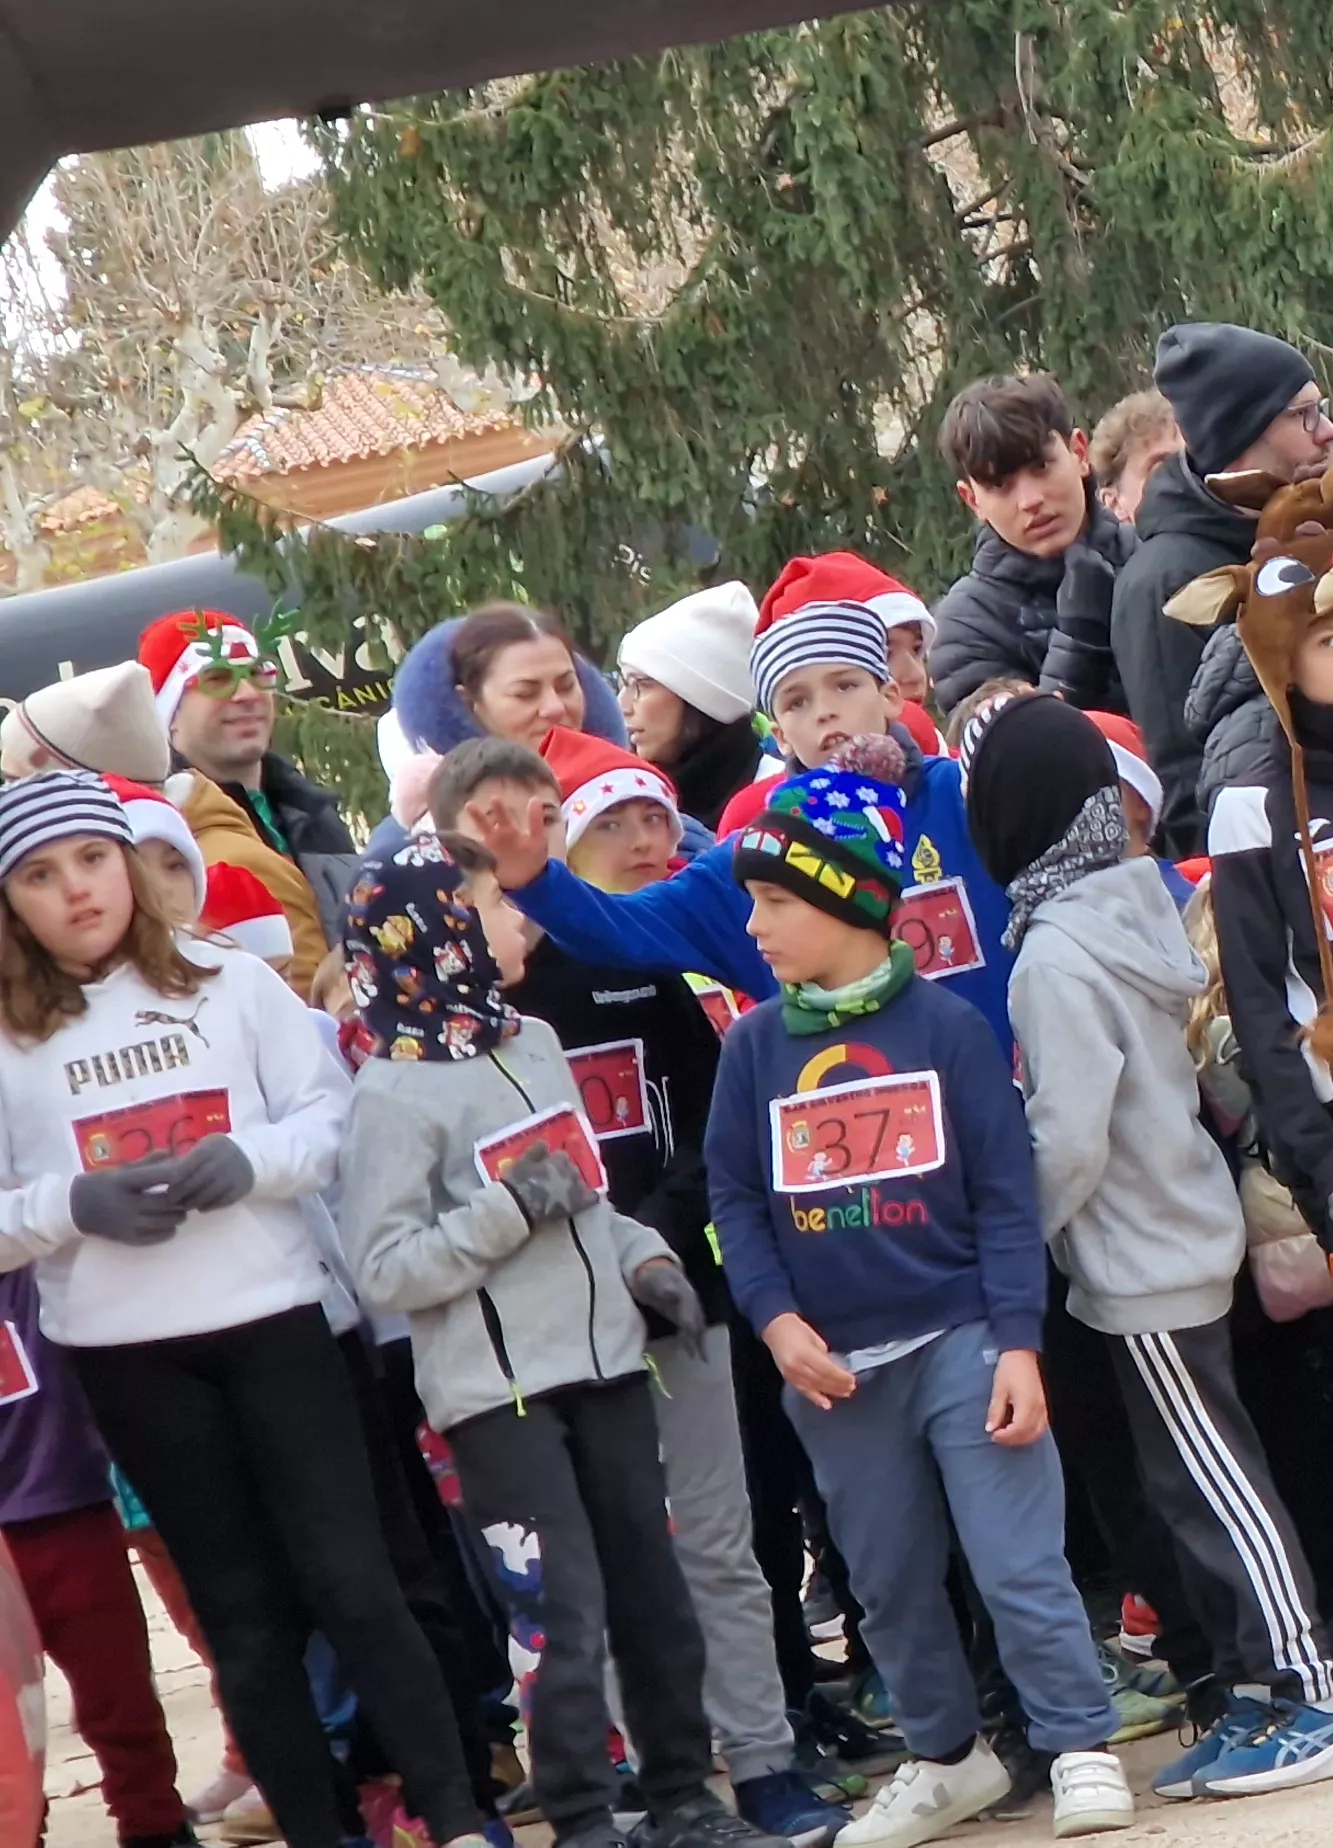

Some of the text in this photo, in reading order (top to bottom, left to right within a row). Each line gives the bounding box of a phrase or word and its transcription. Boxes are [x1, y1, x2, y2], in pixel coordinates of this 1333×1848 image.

[898, 918, 935, 970] 9
[63, 1032, 191, 1096] PUMA
[816, 1108, 891, 1175] 37
